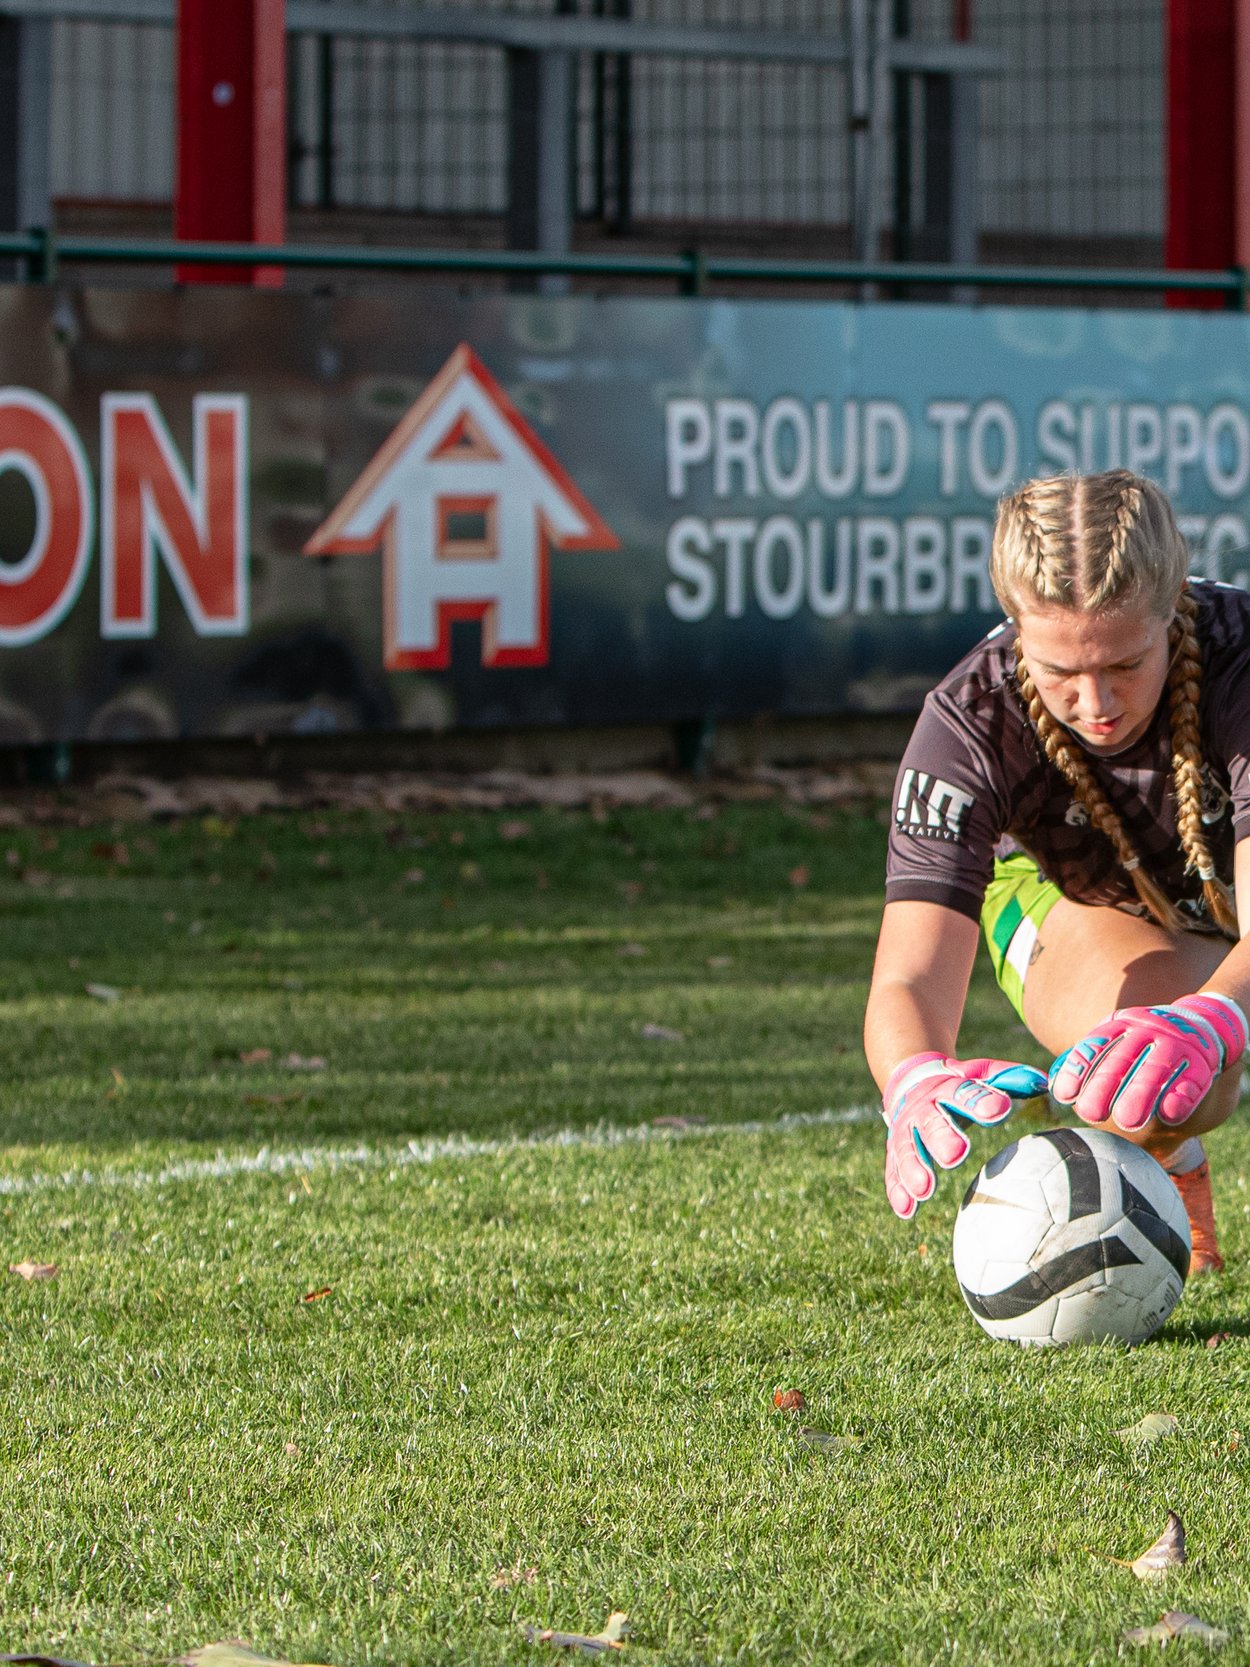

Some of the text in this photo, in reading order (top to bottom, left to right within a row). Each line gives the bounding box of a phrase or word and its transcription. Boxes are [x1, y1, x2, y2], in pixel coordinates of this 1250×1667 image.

[664, 399, 910, 498] PROUD
[928, 400, 1018, 498] TO
[665, 515, 991, 620] STOURBR
